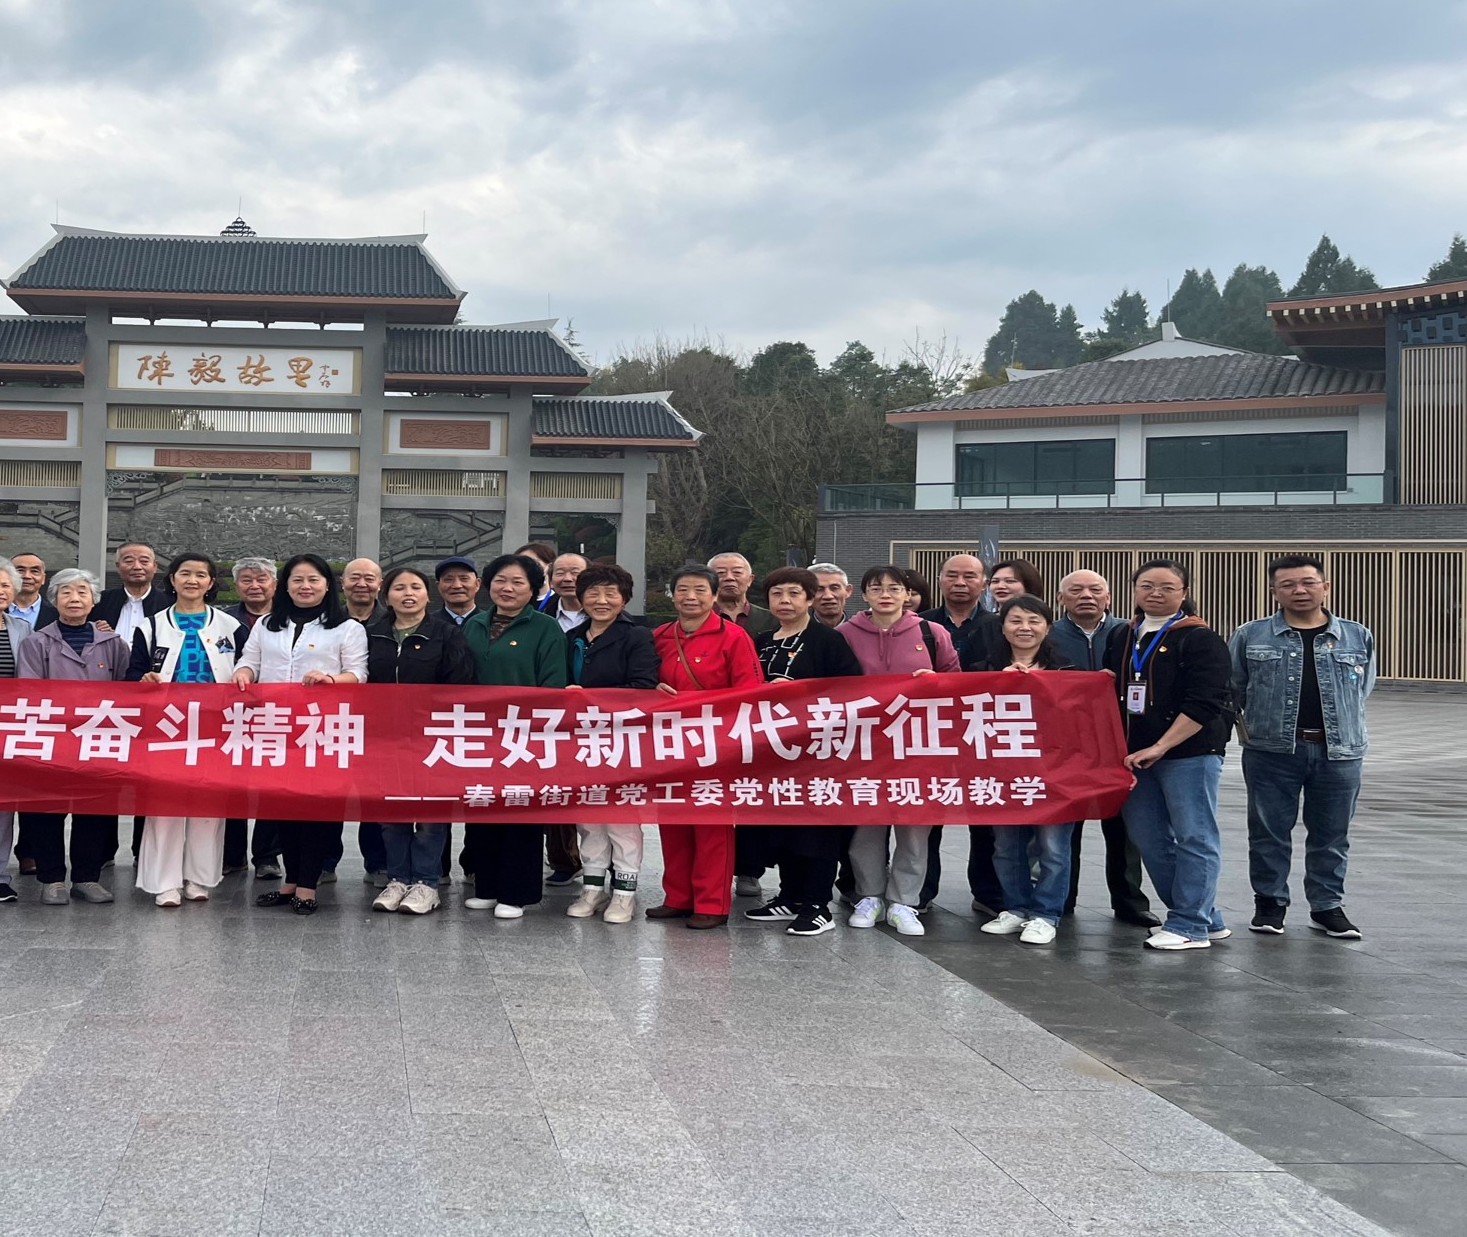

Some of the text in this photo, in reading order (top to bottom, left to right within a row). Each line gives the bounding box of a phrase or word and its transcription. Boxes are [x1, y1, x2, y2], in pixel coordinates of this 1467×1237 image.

[423, 690, 1043, 770] 走好新时代新征程
